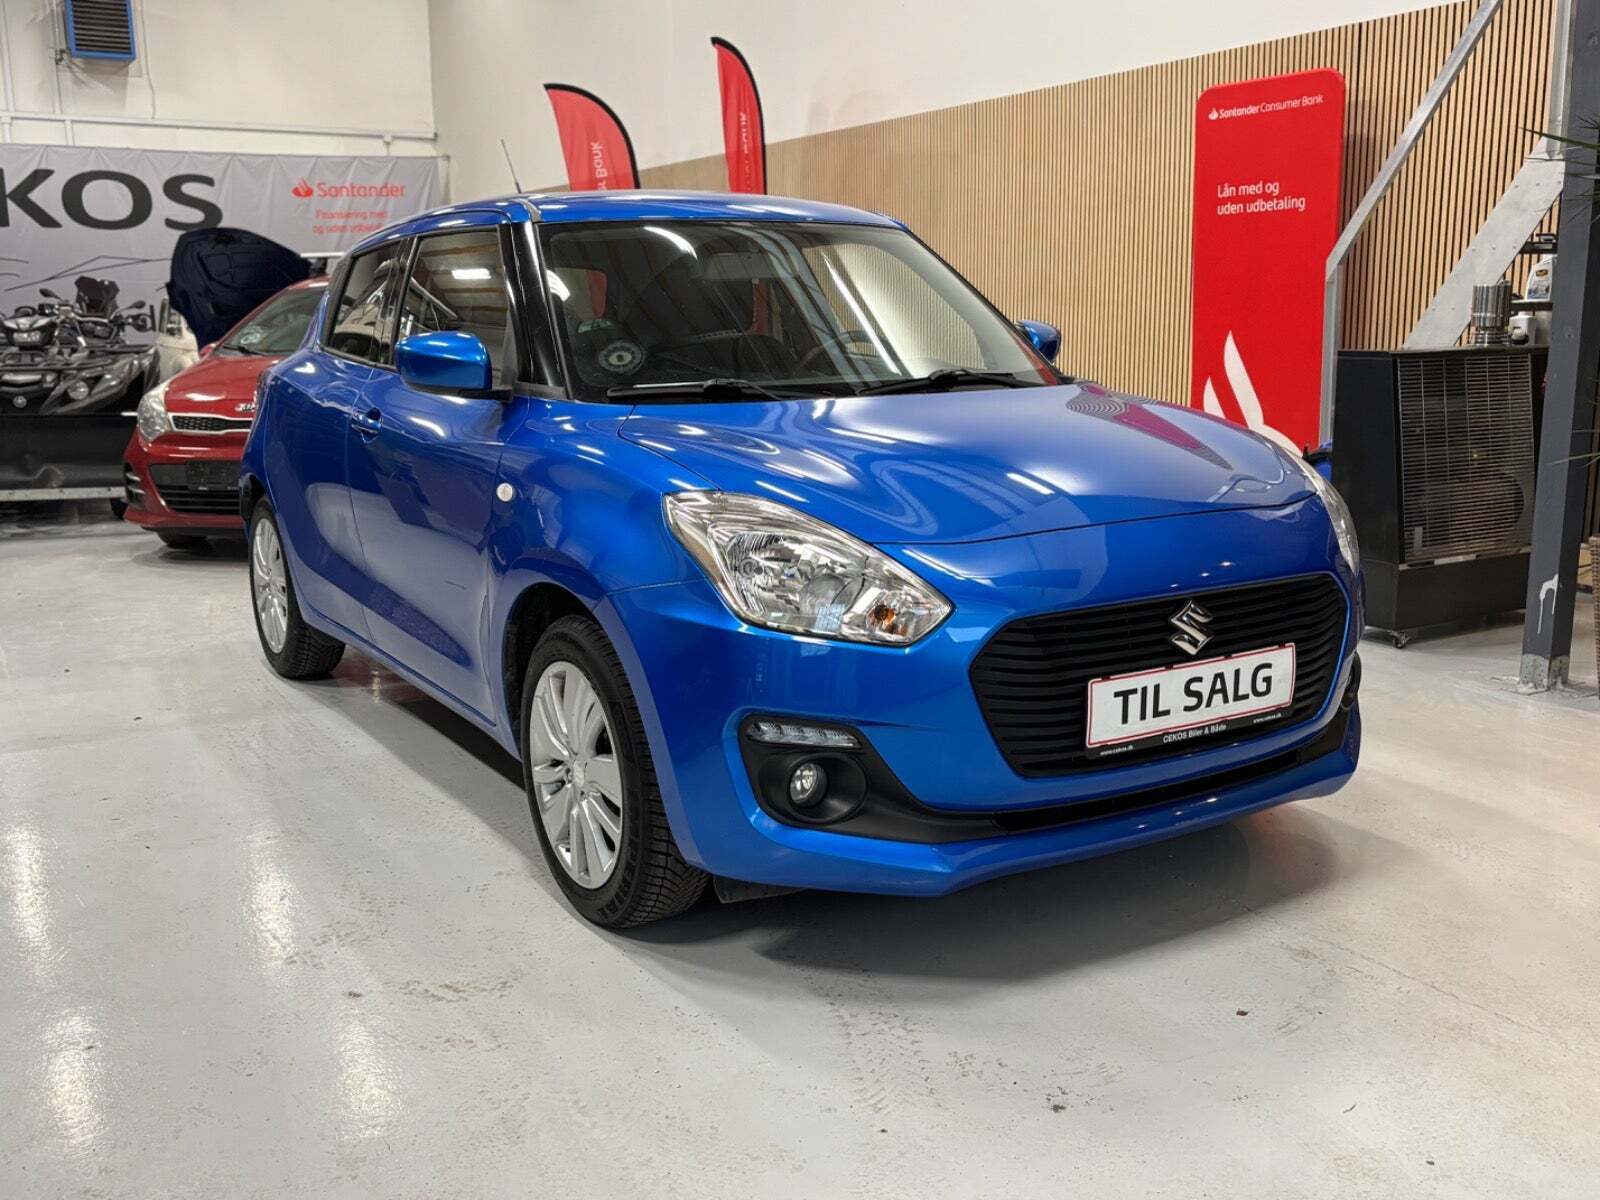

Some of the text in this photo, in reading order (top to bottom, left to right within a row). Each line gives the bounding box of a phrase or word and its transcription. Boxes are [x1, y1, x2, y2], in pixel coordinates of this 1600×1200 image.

[1219, 94, 1324, 119] Santander Consumer Bank
[0, 167, 223, 231] KOS
[317, 181, 406, 198] Santander
[1217, 181, 1280, 198] Lån med og
[1217, 196, 1306, 216] uden udbetaling
[1113, 662, 1273, 725] TIL SALG
[1162, 733, 1188, 743] CEKOS
[1188, 729, 1203, 738] Biler
